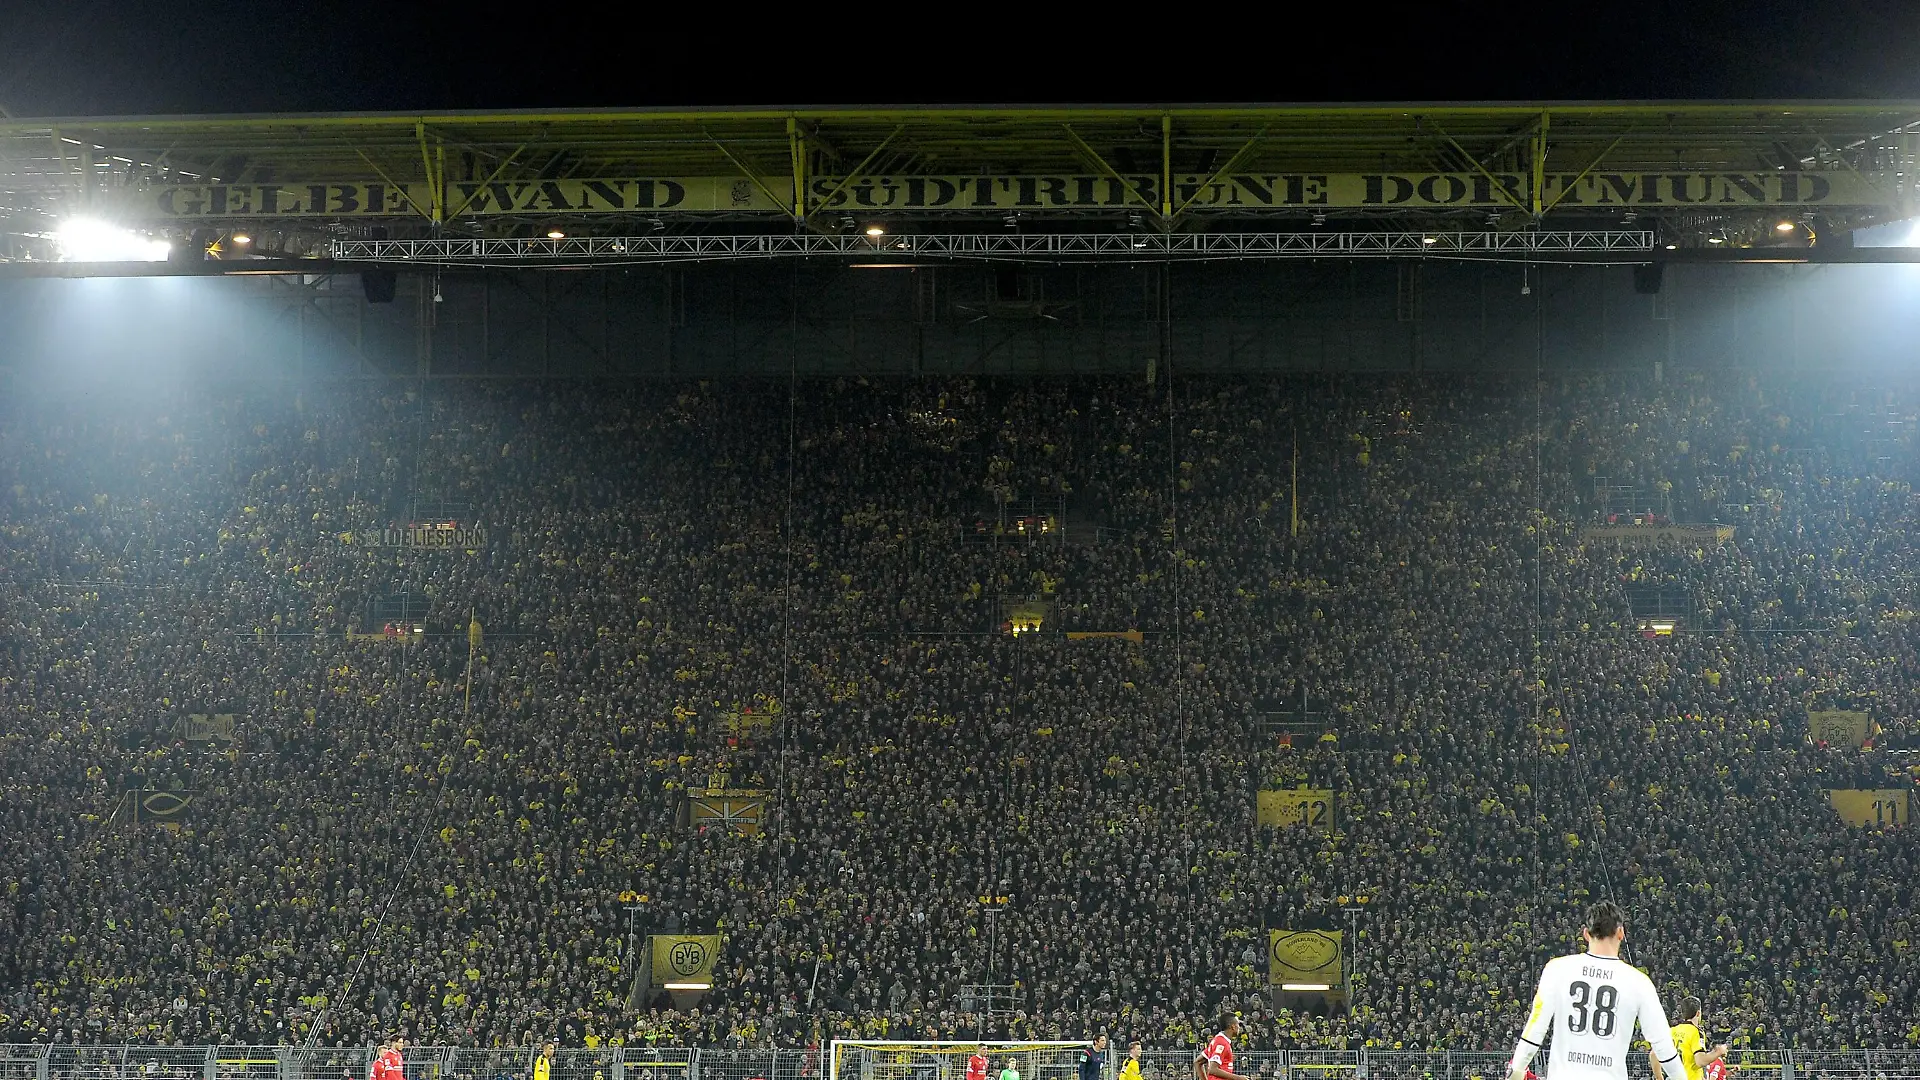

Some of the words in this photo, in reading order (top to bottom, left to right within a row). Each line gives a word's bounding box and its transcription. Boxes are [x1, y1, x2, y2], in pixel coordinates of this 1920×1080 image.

[157, 184, 408, 215] GELBE
[457, 180, 686, 212] WAND
[811, 175, 1328, 209] SÜDTRIBÜNE
[1361, 173, 1831, 204] DORTMUND
[1297, 800, 1328, 826] 12
[1871, 801, 1897, 824] 11
[676, 945, 700, 965] BVB
[1582, 965, 1614, 980] BÜRKI
[1568, 980, 1620, 1041] 38
[1567, 1051, 1612, 1067] DORTMUND
